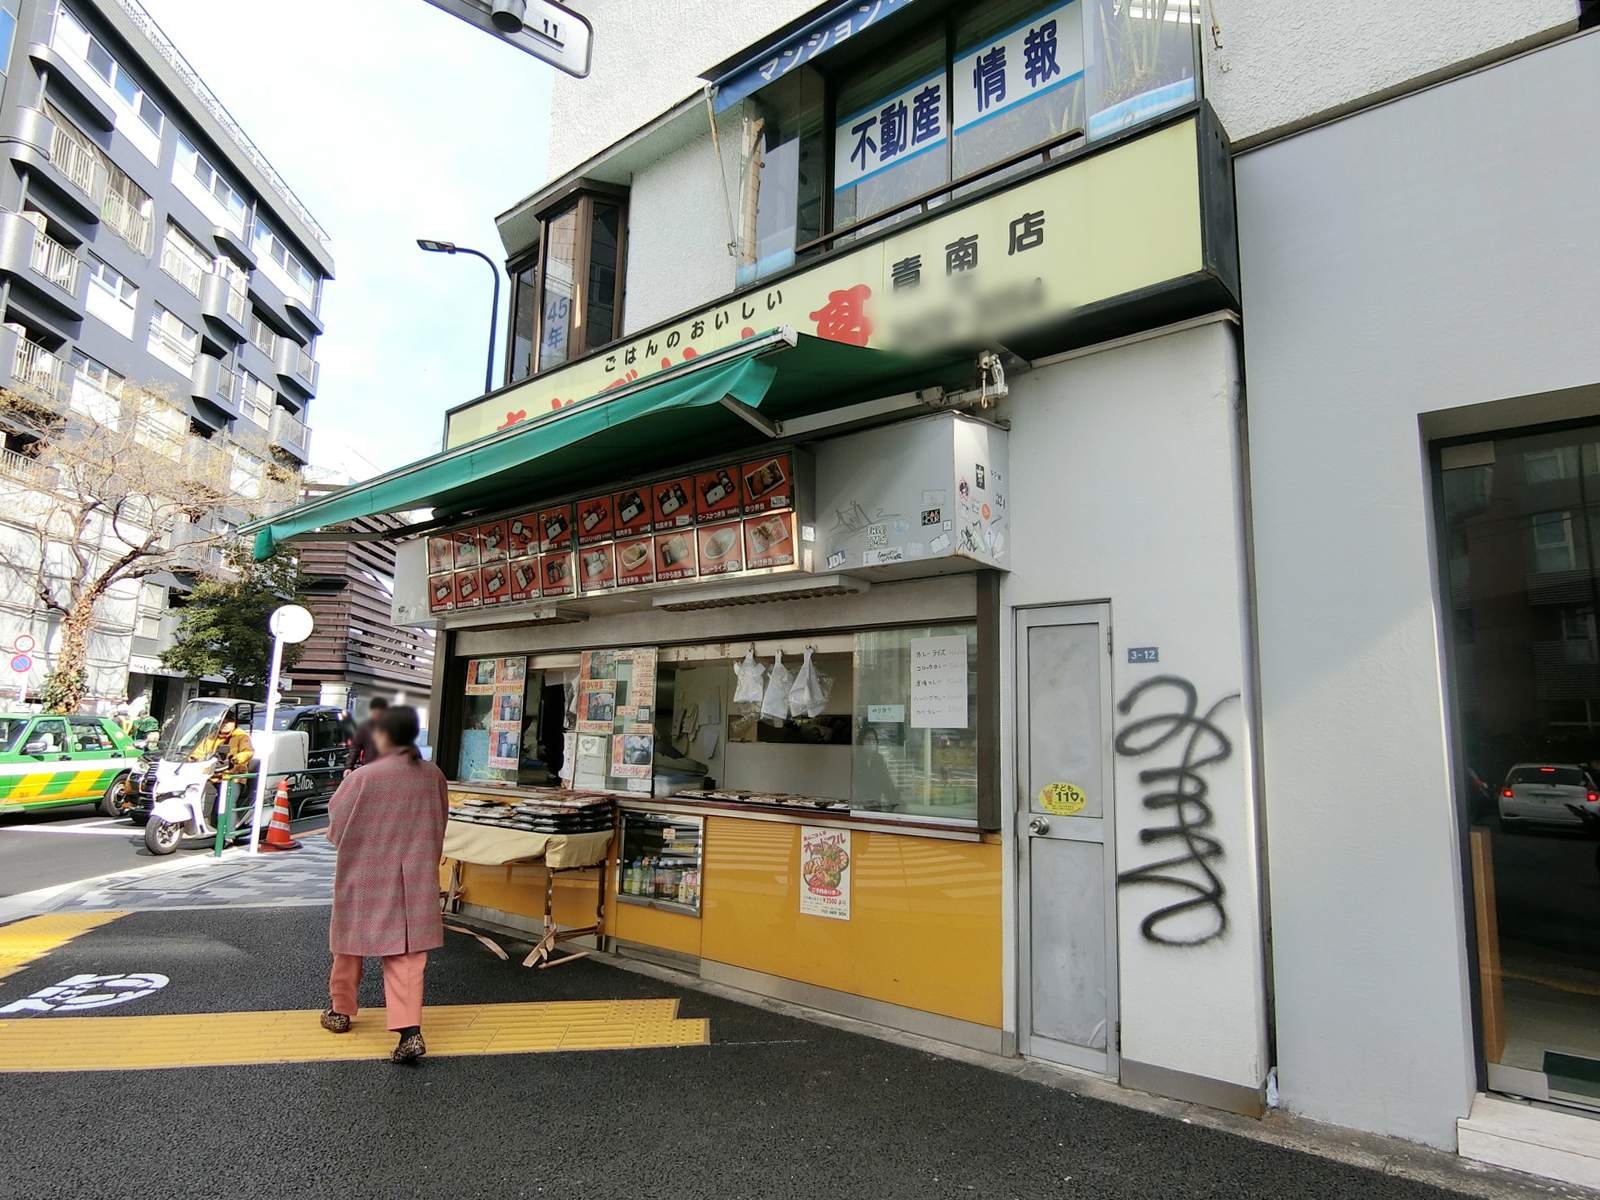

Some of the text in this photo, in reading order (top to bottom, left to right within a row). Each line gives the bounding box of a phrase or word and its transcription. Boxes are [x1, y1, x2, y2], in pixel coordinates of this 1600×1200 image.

[543, 18, 558, 39] 11
[758, 0, 913, 80] マンション
[849, 18, 1062, 172] 不動産 情報
[890, 210, 1047, 294] 青南店
[604, 289, 785, 373] ごはんのおいしい
[744, 502, 765, 513] のり弁当
[922, 509, 940, 518] PEAK
[922, 516, 940, 526] HOUR
[1130, 650, 1156, 660] 3-12
[1052, 783, 1074, 792] 子ども
